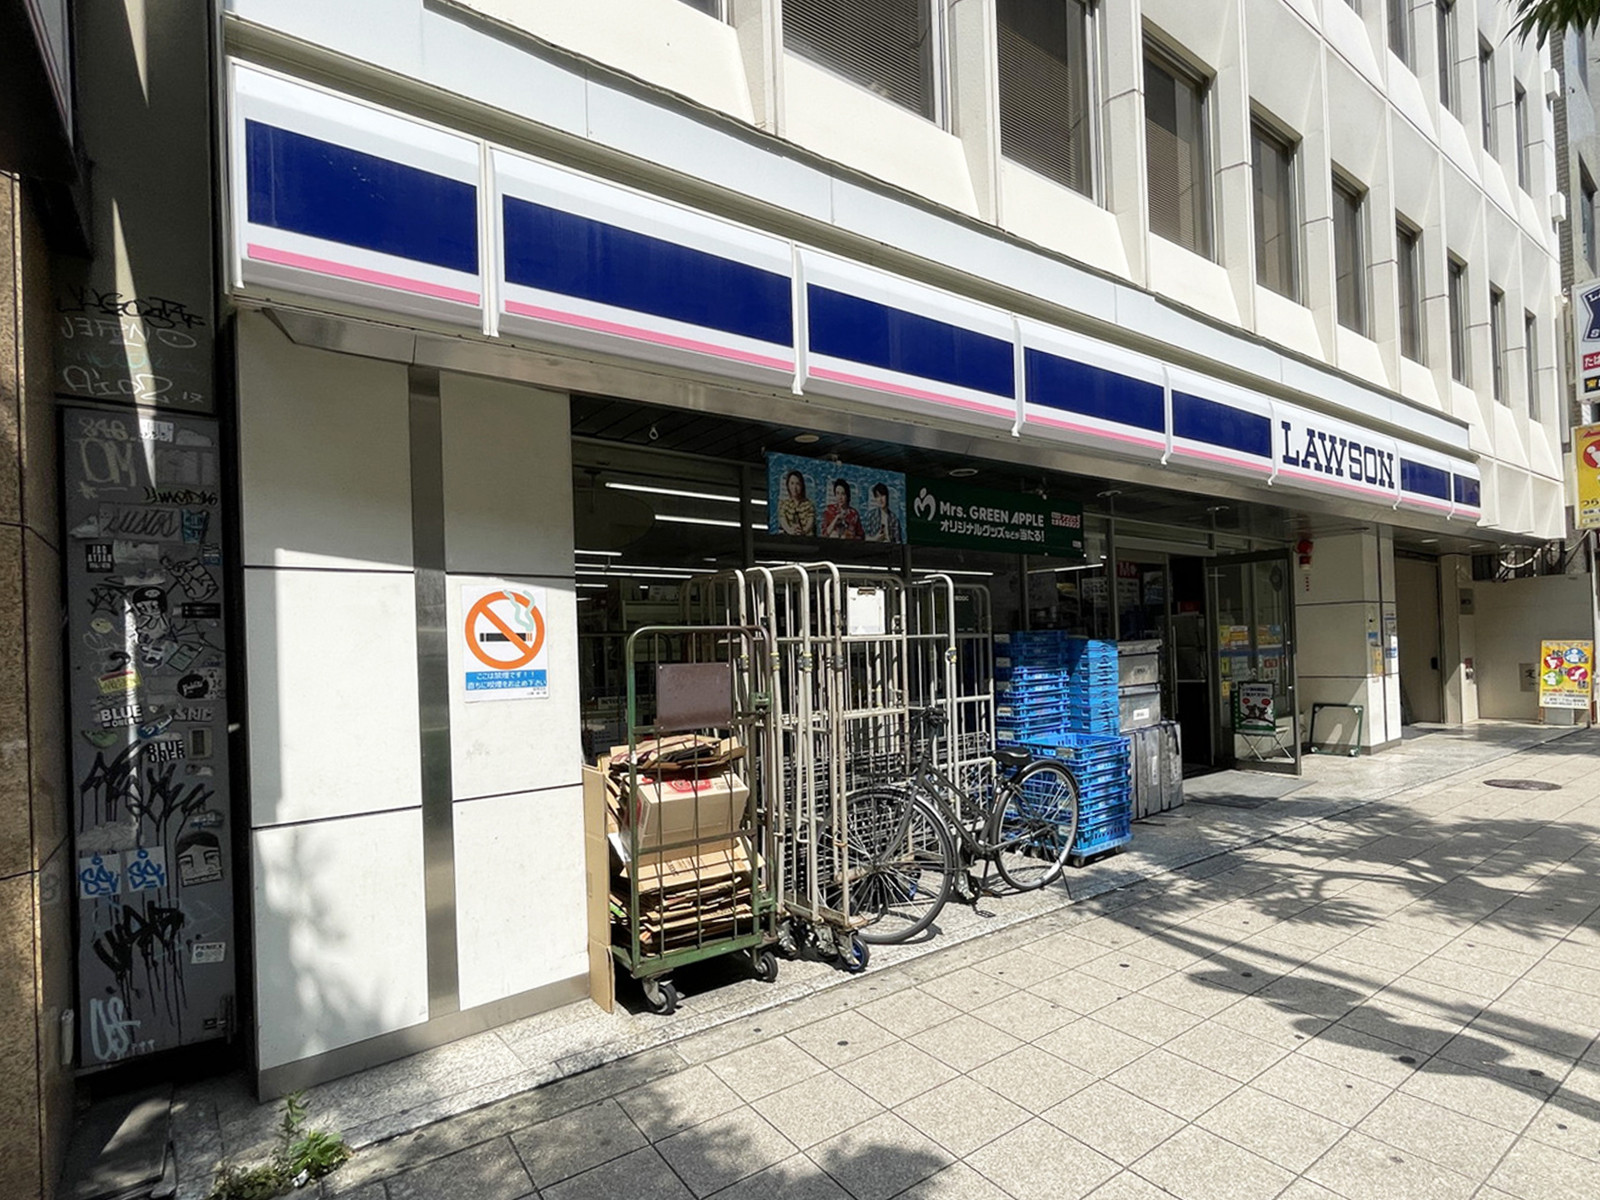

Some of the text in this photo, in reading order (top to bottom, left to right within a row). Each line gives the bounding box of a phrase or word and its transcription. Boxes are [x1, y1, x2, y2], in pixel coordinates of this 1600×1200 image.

[1281, 420, 1395, 489] LAWSON
[940, 502, 967, 519] Mrs.
[969, 505, 1009, 523] GREEN
[1011, 511, 1045, 528] APPLE
[100, 704, 143, 721] BLUE
[148, 740, 185, 753] BLUE
